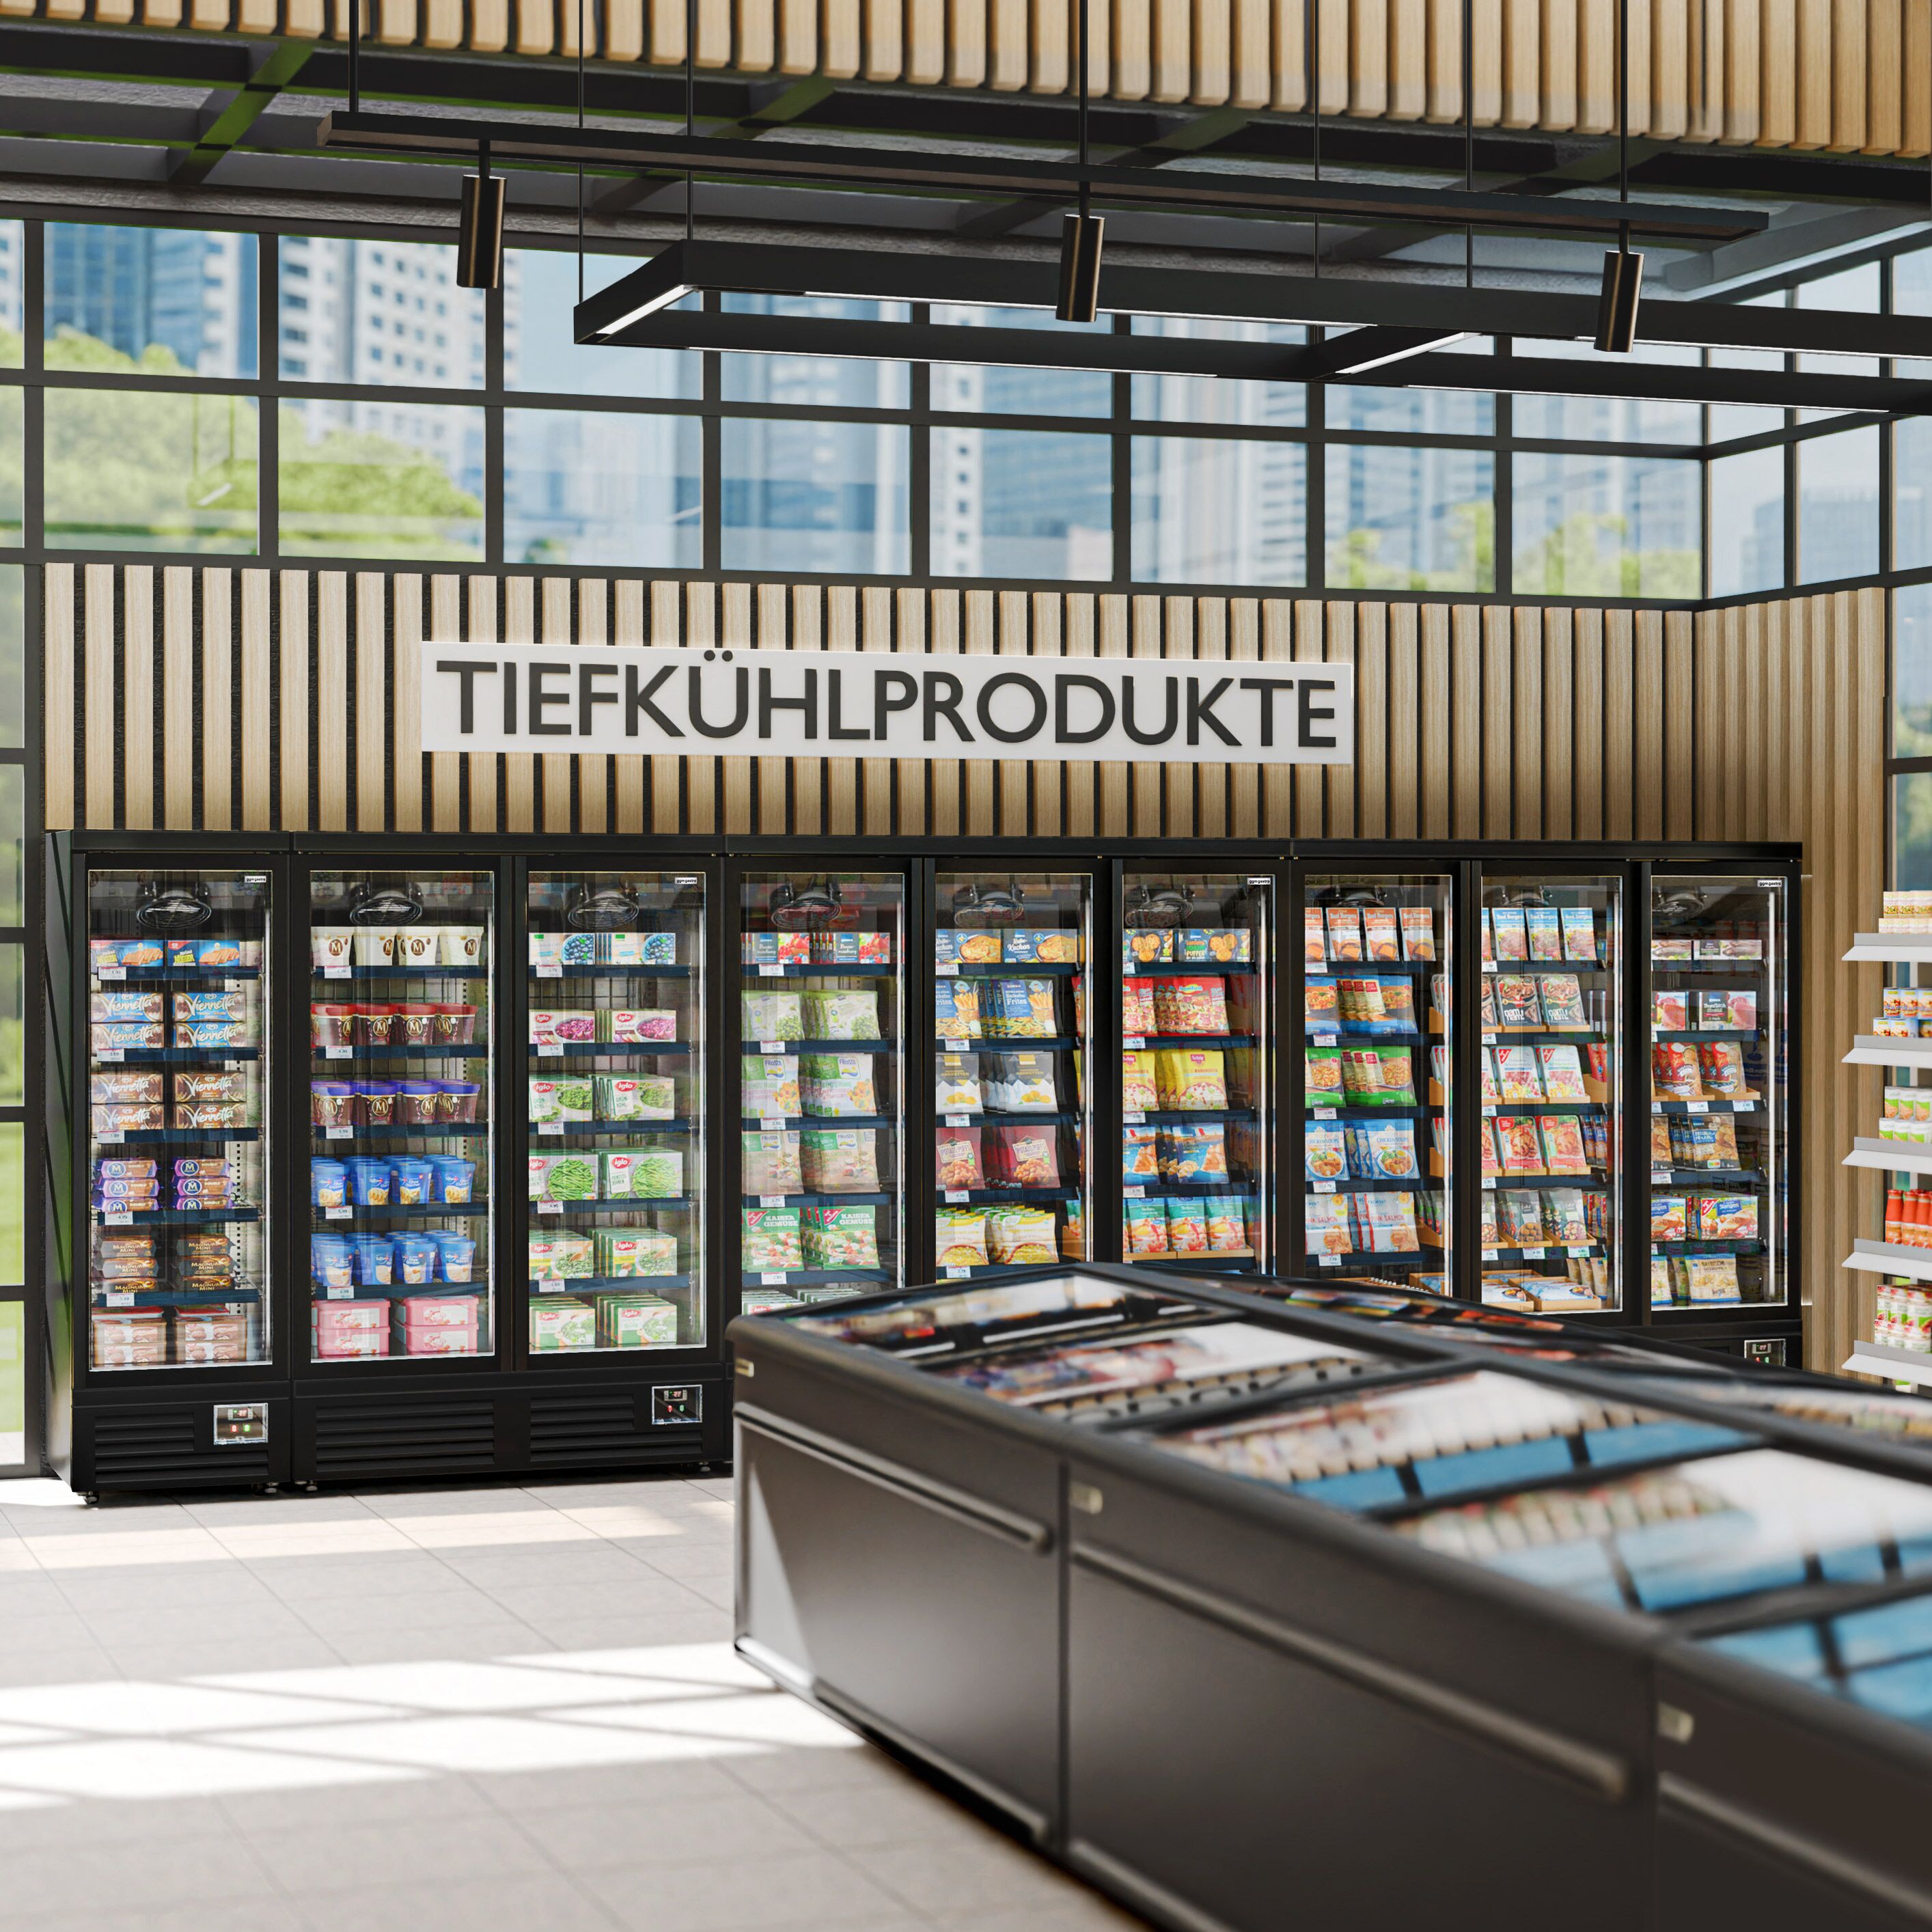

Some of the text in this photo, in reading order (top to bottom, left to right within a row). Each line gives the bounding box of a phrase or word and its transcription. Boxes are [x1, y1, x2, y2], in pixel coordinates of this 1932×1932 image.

[436, 649, 1337, 747] TIEFKÜHLPRODUKTE
[101, 995, 152, 1017] Viennetta
[185, 994, 236, 1017] Viennetta
[104, 1025, 153, 1048] Viennetta
[186, 1024, 237, 1047] Viennetta
[101, 1076, 150, 1098] Viennetta
[184, 1076, 233, 1097] Viennetta
[102, 1107, 150, 1129] Viennetta
[186, 1107, 234, 1129] Viennetta
